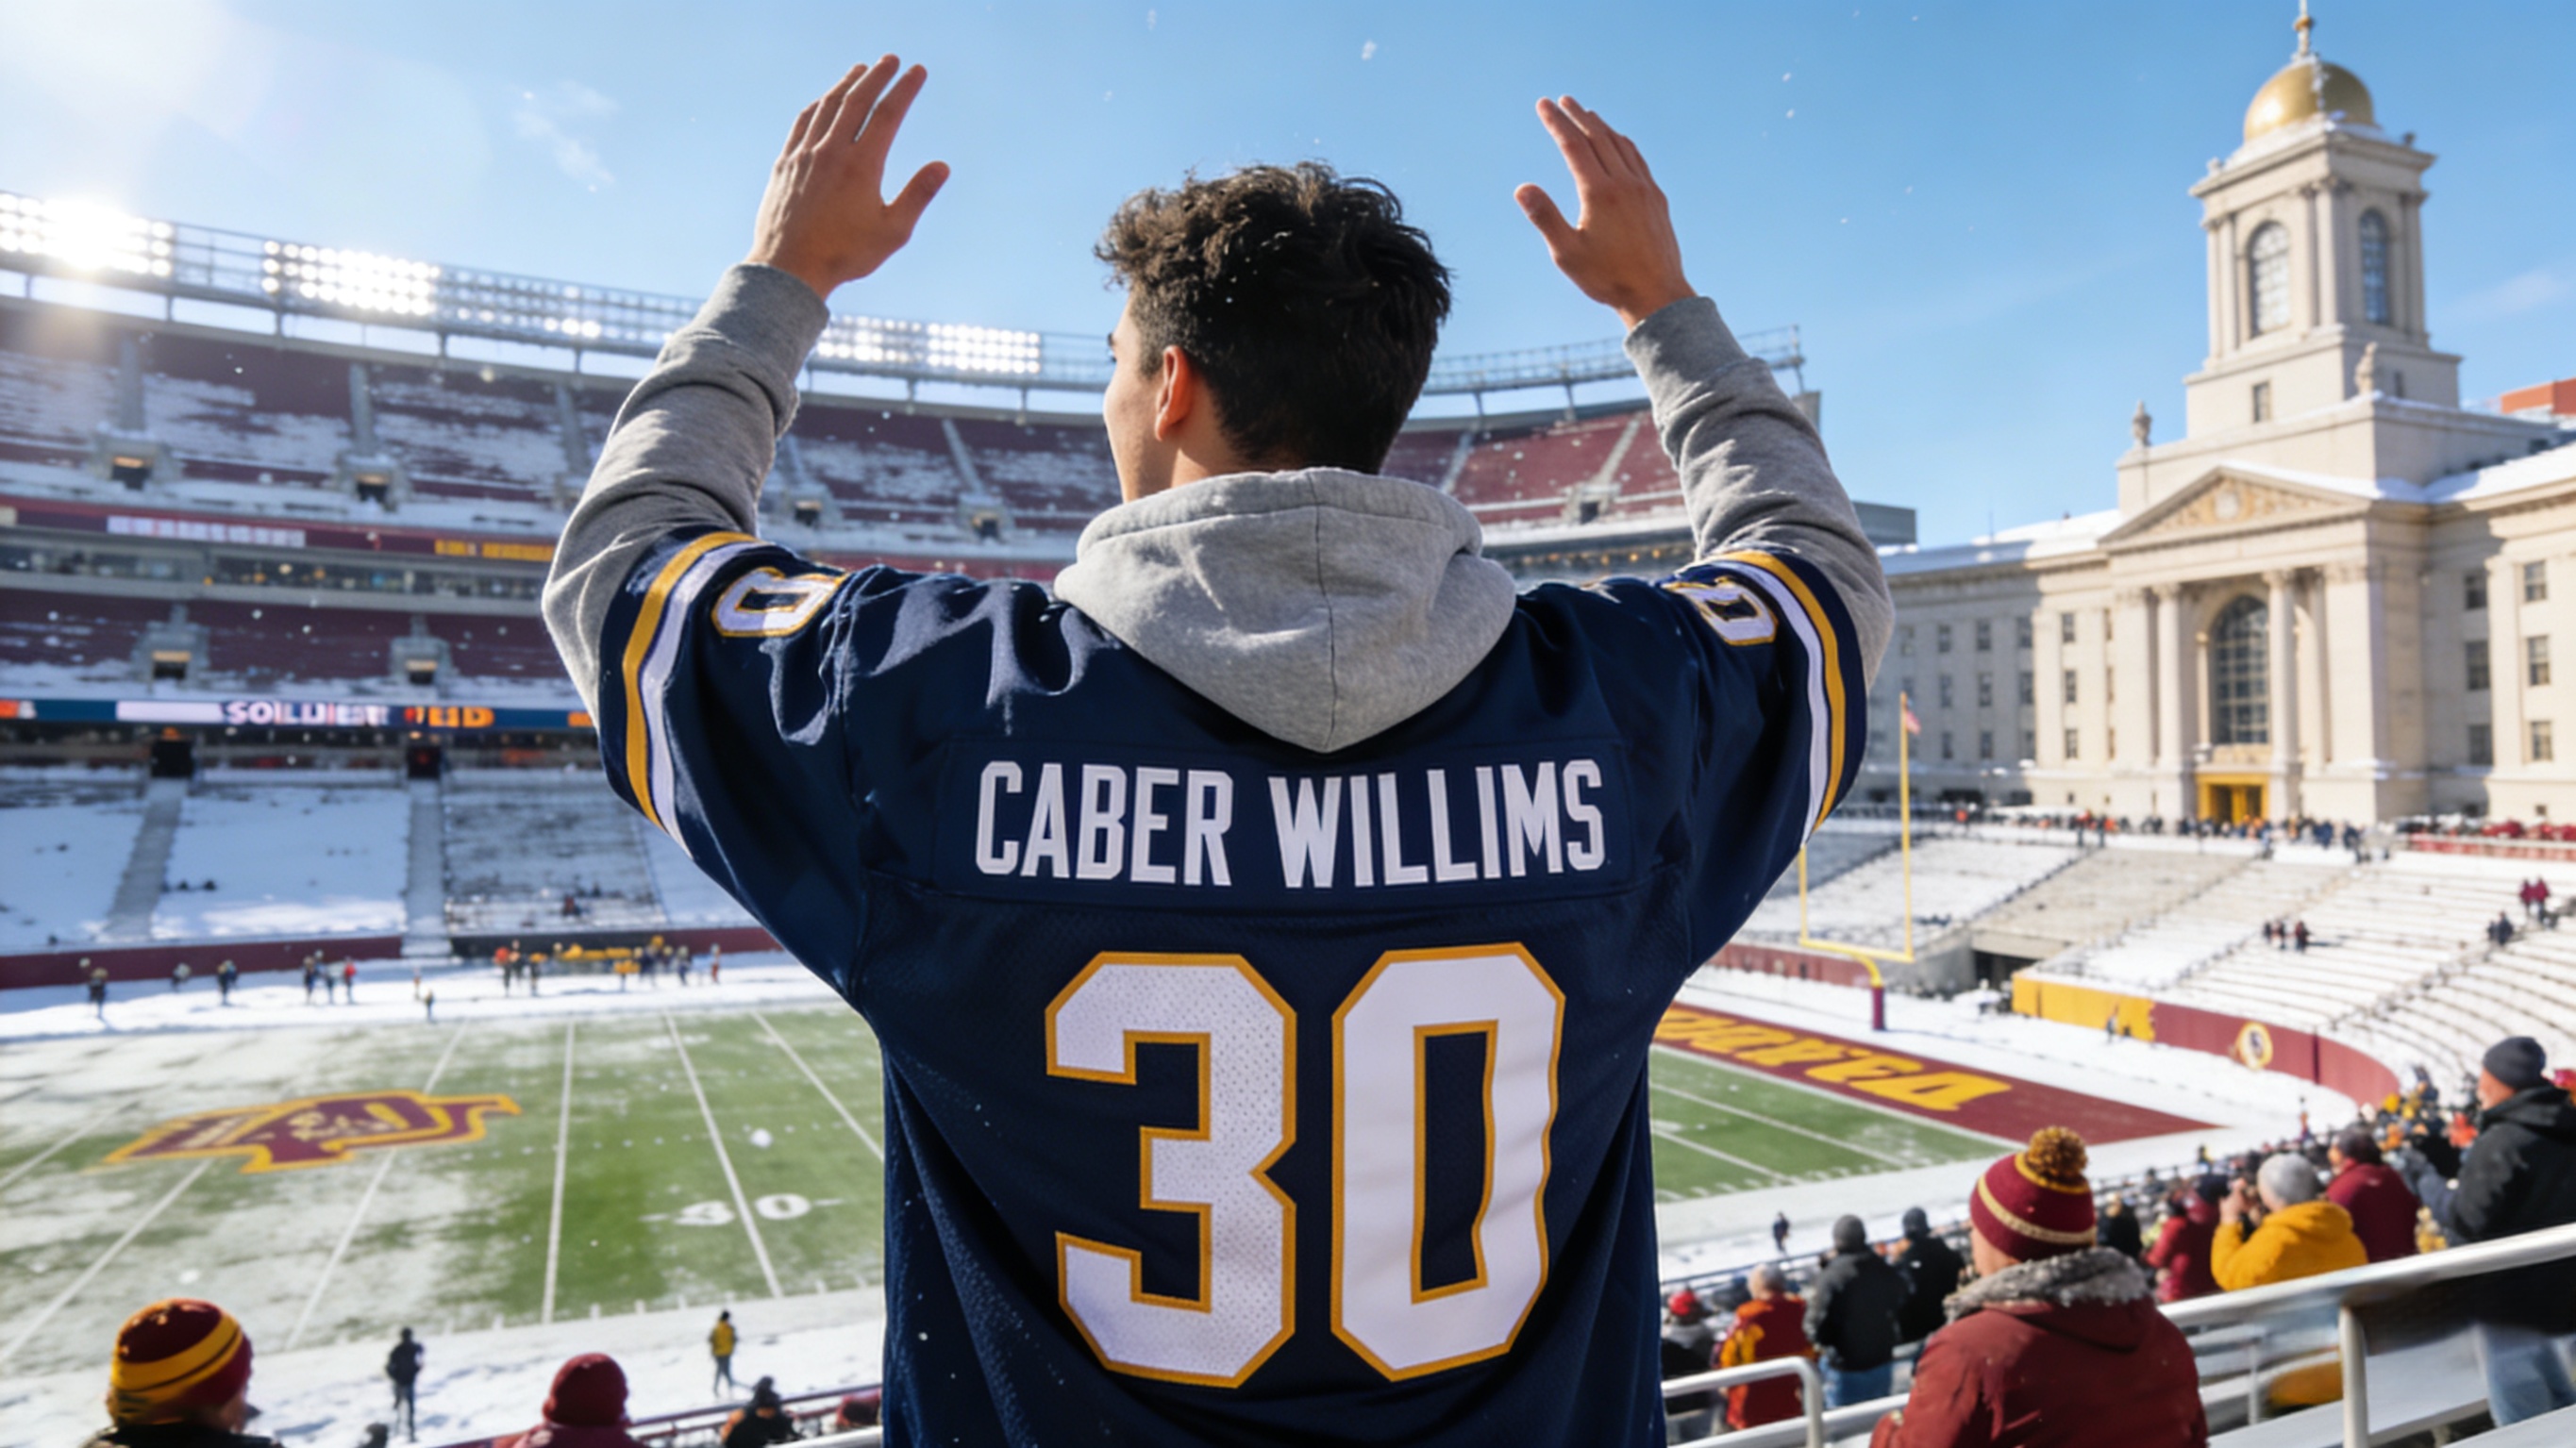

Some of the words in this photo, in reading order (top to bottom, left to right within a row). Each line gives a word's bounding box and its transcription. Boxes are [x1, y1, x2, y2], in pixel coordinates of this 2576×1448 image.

[975, 760, 1233, 886] CABER
[1268, 759, 1604, 889] WILLIMS
[1045, 941, 1566, 1389] 30
